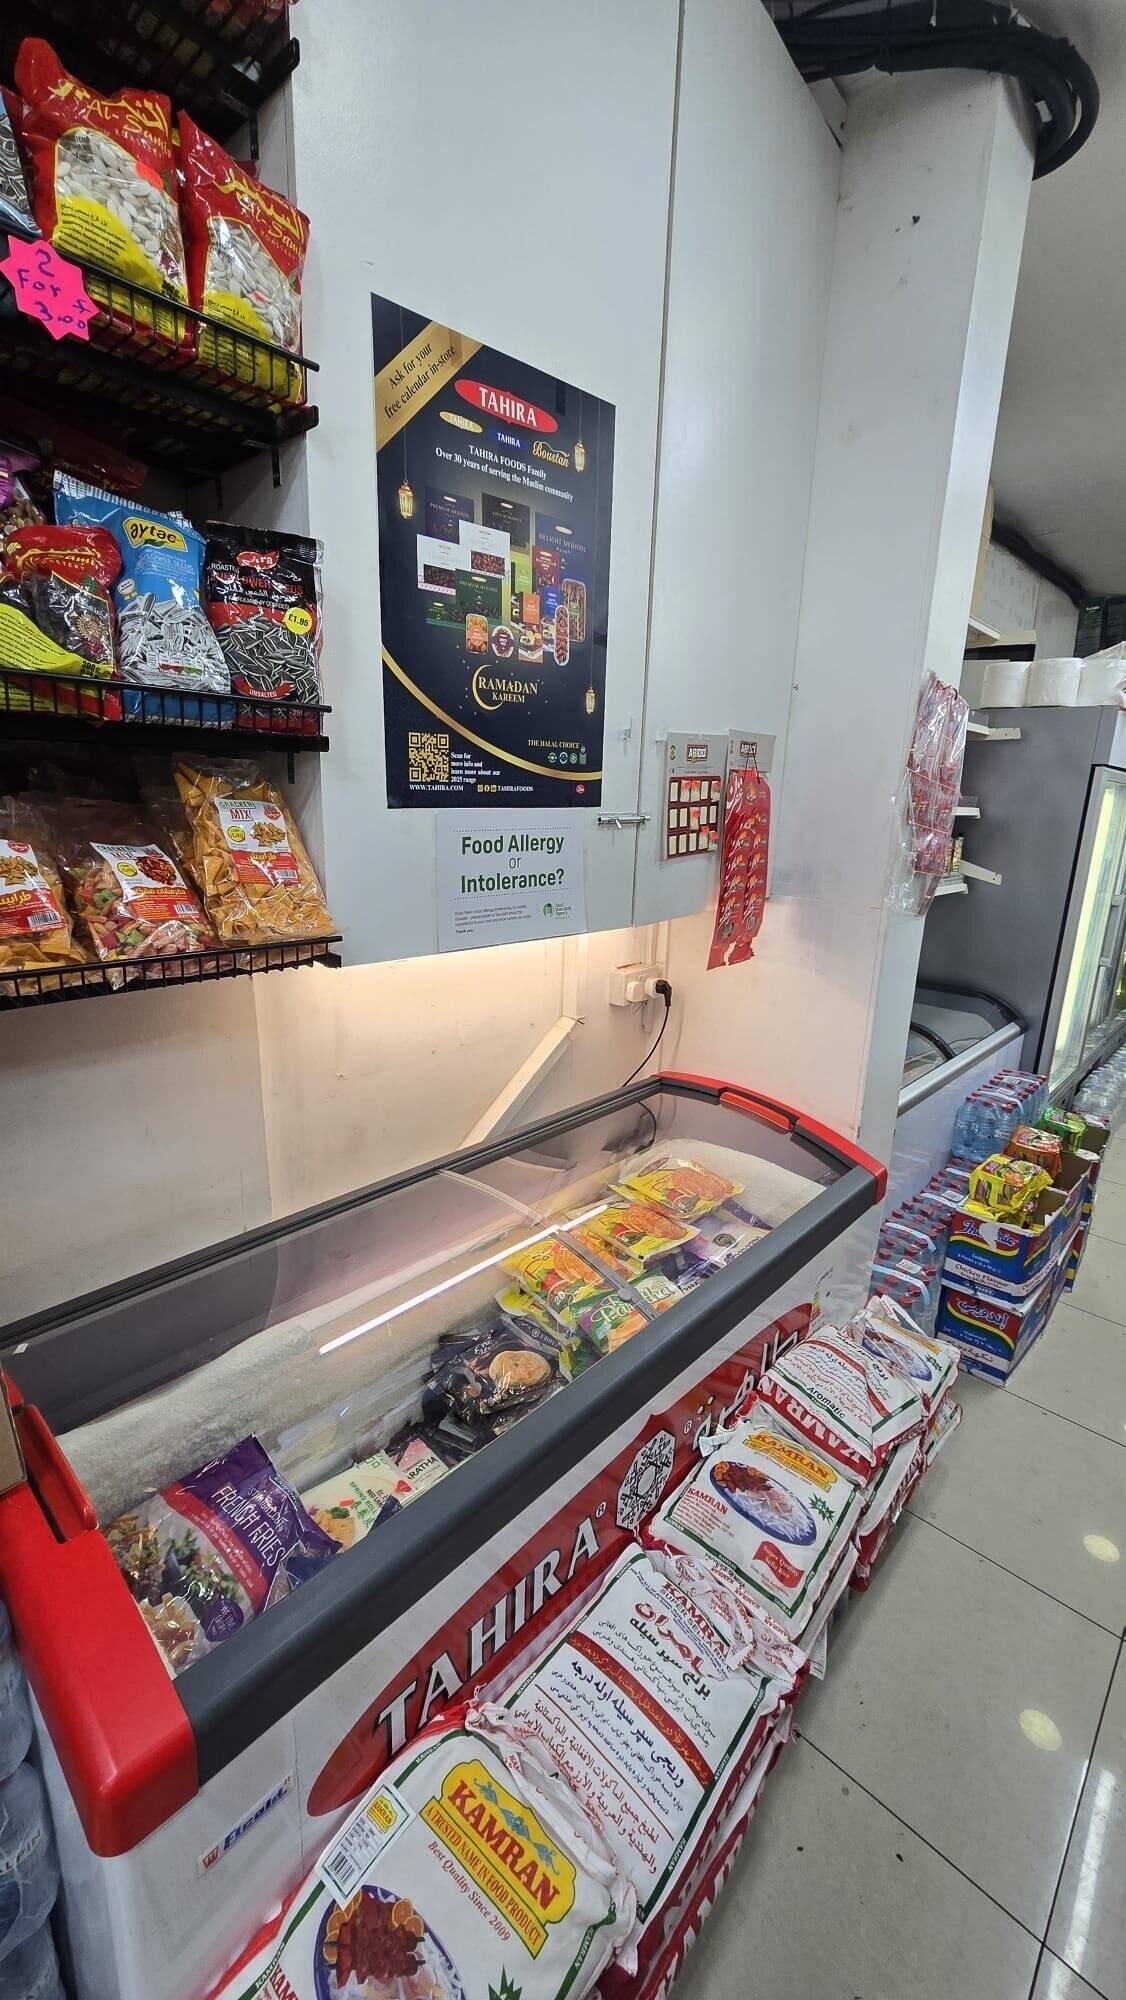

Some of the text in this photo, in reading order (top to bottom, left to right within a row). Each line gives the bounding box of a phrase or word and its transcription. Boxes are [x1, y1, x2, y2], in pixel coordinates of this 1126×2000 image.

[36, 249, 55, 277] 2
[389, 343, 432, 390] Ask for your
[384, 345, 456, 419] free calendar in-store
[479, 387, 538, 427] TAHIRA
[496, 432, 521, 448] TAHIRA
[436, 448, 453, 462] Over
[454, 453, 462, 464] 30
[463, 457, 480, 470] years
[481, 460, 488, 472] of
[489, 465, 511, 482] serving
[512, 471, 522, 482] the
[544, 482, 573, 502] community
[468, 444, 547, 480] TAHIRA FOODS Family
[131, 523, 177, 543] aytac
[288, 614, 309, 626] £1.95
[250, 689, 277, 698] UNSALTED
[478, 676, 538, 694] RAMADAN
[492, 691, 525, 704] KAREEM
[451, 752, 472, 760] Scan for
[528, 739, 579, 749] THE HALAL CHOICE
[230, 809, 253, 821] MIX
[462, 834, 564, 854] Food Allergy
[509, 857, 521, 869] or
[462, 868, 564, 893] Intolerance?
[954, 1263, 981, 1277] Chicken
[806, 1385, 846, 1418] Aromatic
[406, 1455, 437, 1482] RATHA
[755, 1432, 828, 1478] KAMRAN
[349, 1481, 377, 1514] SPRING ROLL
[688, 1487, 728, 1514] KAMRAN
[212, 1486, 258, 1528] FRENCH
[248, 1524, 287, 1566] FRIES
[762, 1545, 799, 1577] Super Quality
[778, 1567, 790, 1578] Rice
[659, 1588, 688, 1617] SUPER
[686, 1618, 714, 1648] SELLA
[372, 1516, 600, 1758] TAHIRA
[372, 1801, 393, 1824] KAMRAN
[446, 1783, 558, 1908] KAMRAN
[424, 1805, 542, 1945] A TRUSTED NAME IN FOOD PRODUCT
[428, 1840, 512, 1942] Best Quality Since 2009
[575, 1926, 596, 1970] KAMRAN
[256, 1943, 285, 1988] KAMRAN
